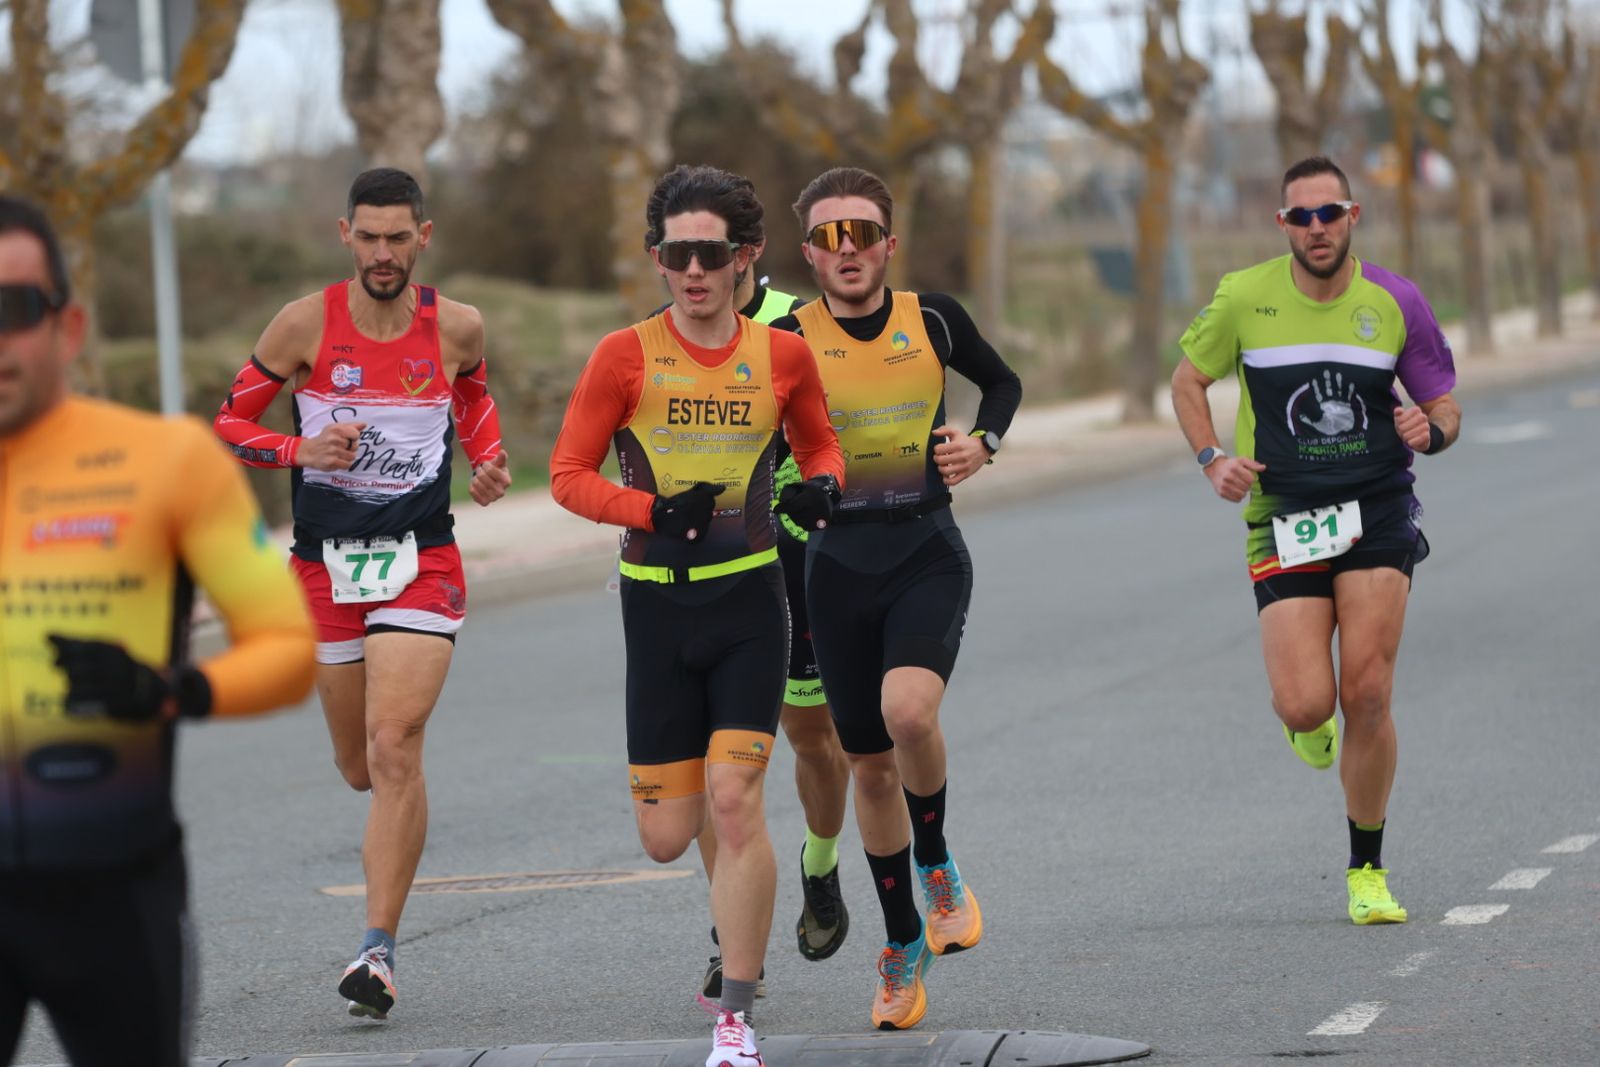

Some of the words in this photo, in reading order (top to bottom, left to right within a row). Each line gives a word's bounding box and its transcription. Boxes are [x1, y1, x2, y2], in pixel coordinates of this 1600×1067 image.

[667, 394, 752, 426] ESTÉVEZ
[1294, 513, 1338, 544] 91
[345, 551, 396, 582] 77
